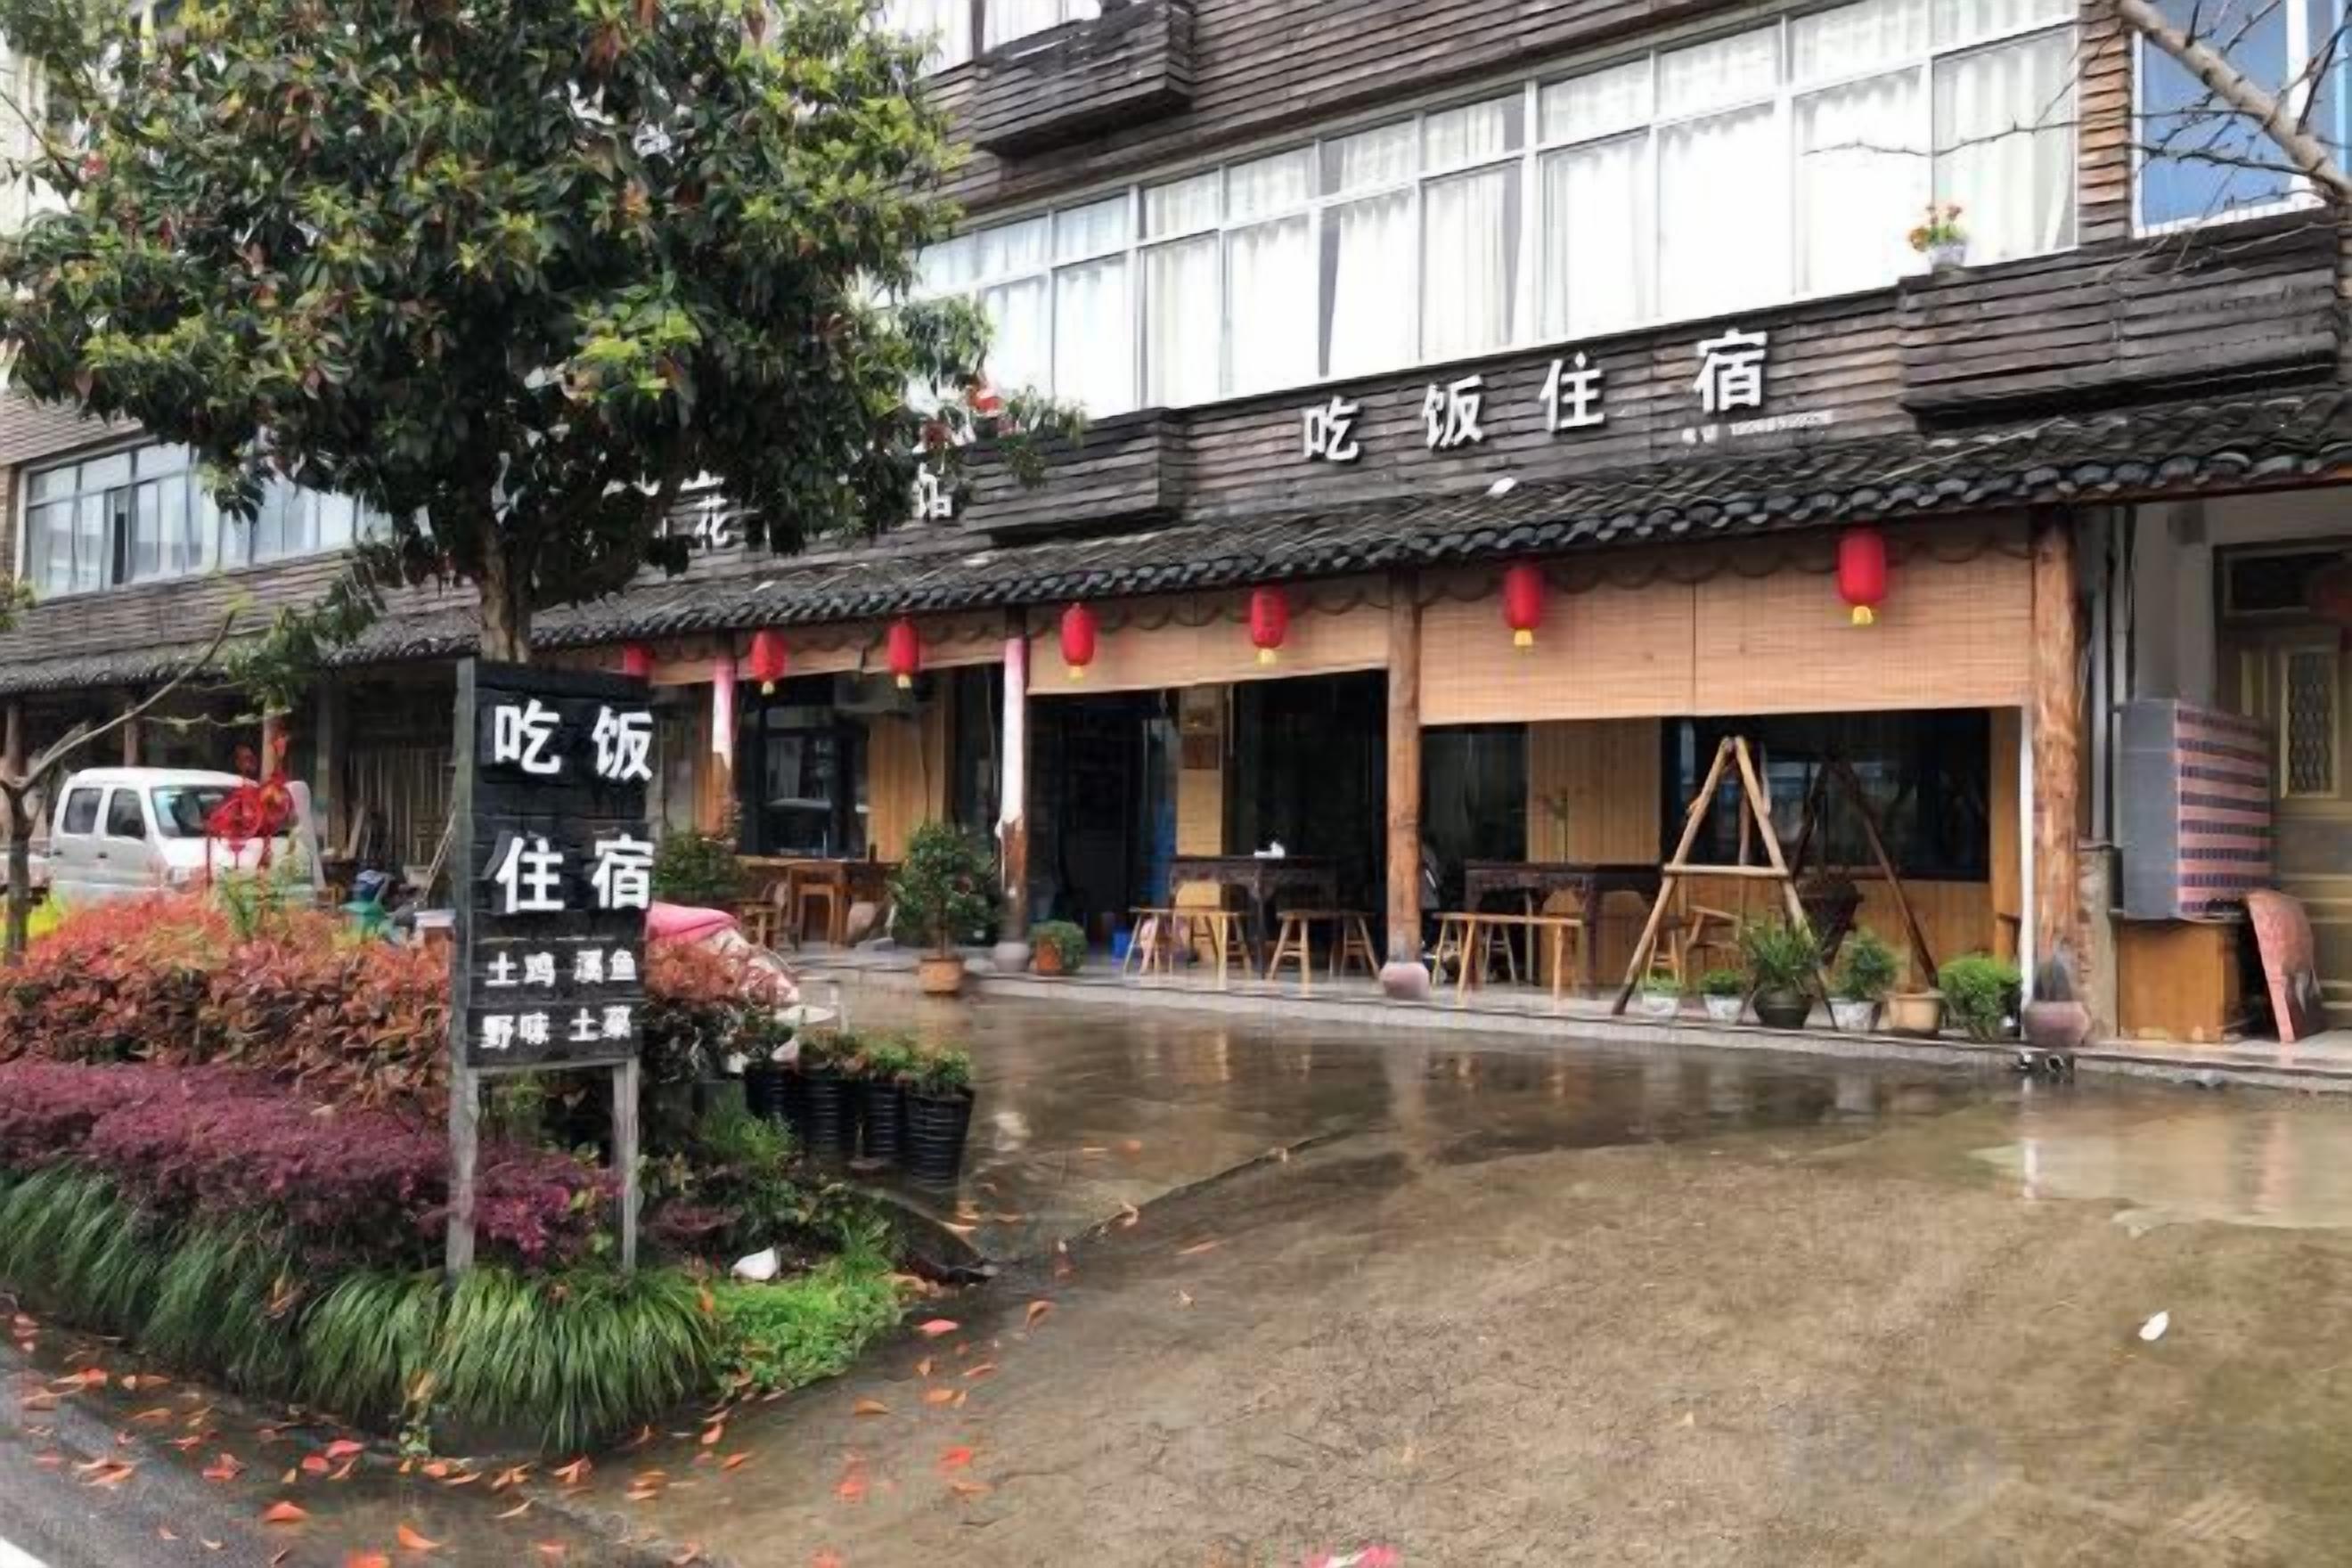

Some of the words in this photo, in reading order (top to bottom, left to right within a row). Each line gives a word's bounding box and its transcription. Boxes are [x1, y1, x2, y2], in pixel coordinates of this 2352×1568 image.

[1303, 329, 1768, 462] 吃饭住宿
[494, 698, 653, 780] 吃饭
[495, 833, 656, 914] 住宿
[485, 951, 556, 987] 土鸡
[479, 1010, 550, 1049] 野味
